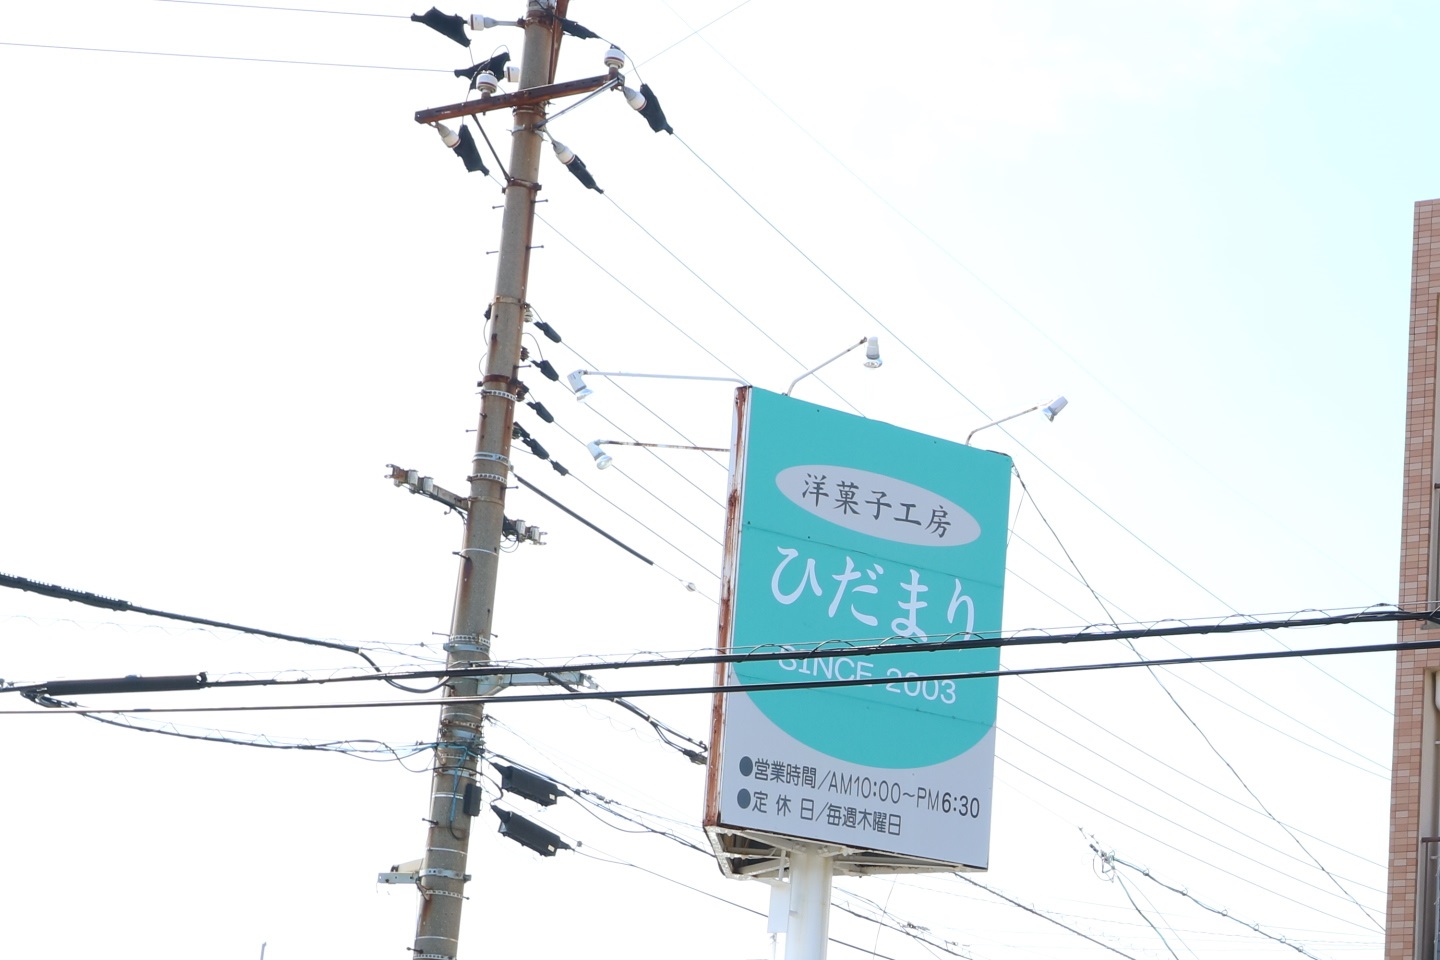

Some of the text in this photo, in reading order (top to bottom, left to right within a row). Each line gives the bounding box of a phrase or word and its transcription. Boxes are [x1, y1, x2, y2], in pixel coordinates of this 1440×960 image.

[802, 472, 952, 538] 洋菓子工房
[771, 546, 975, 652] ひだまり
[778, 645, 957, 705] SINCE 2003
